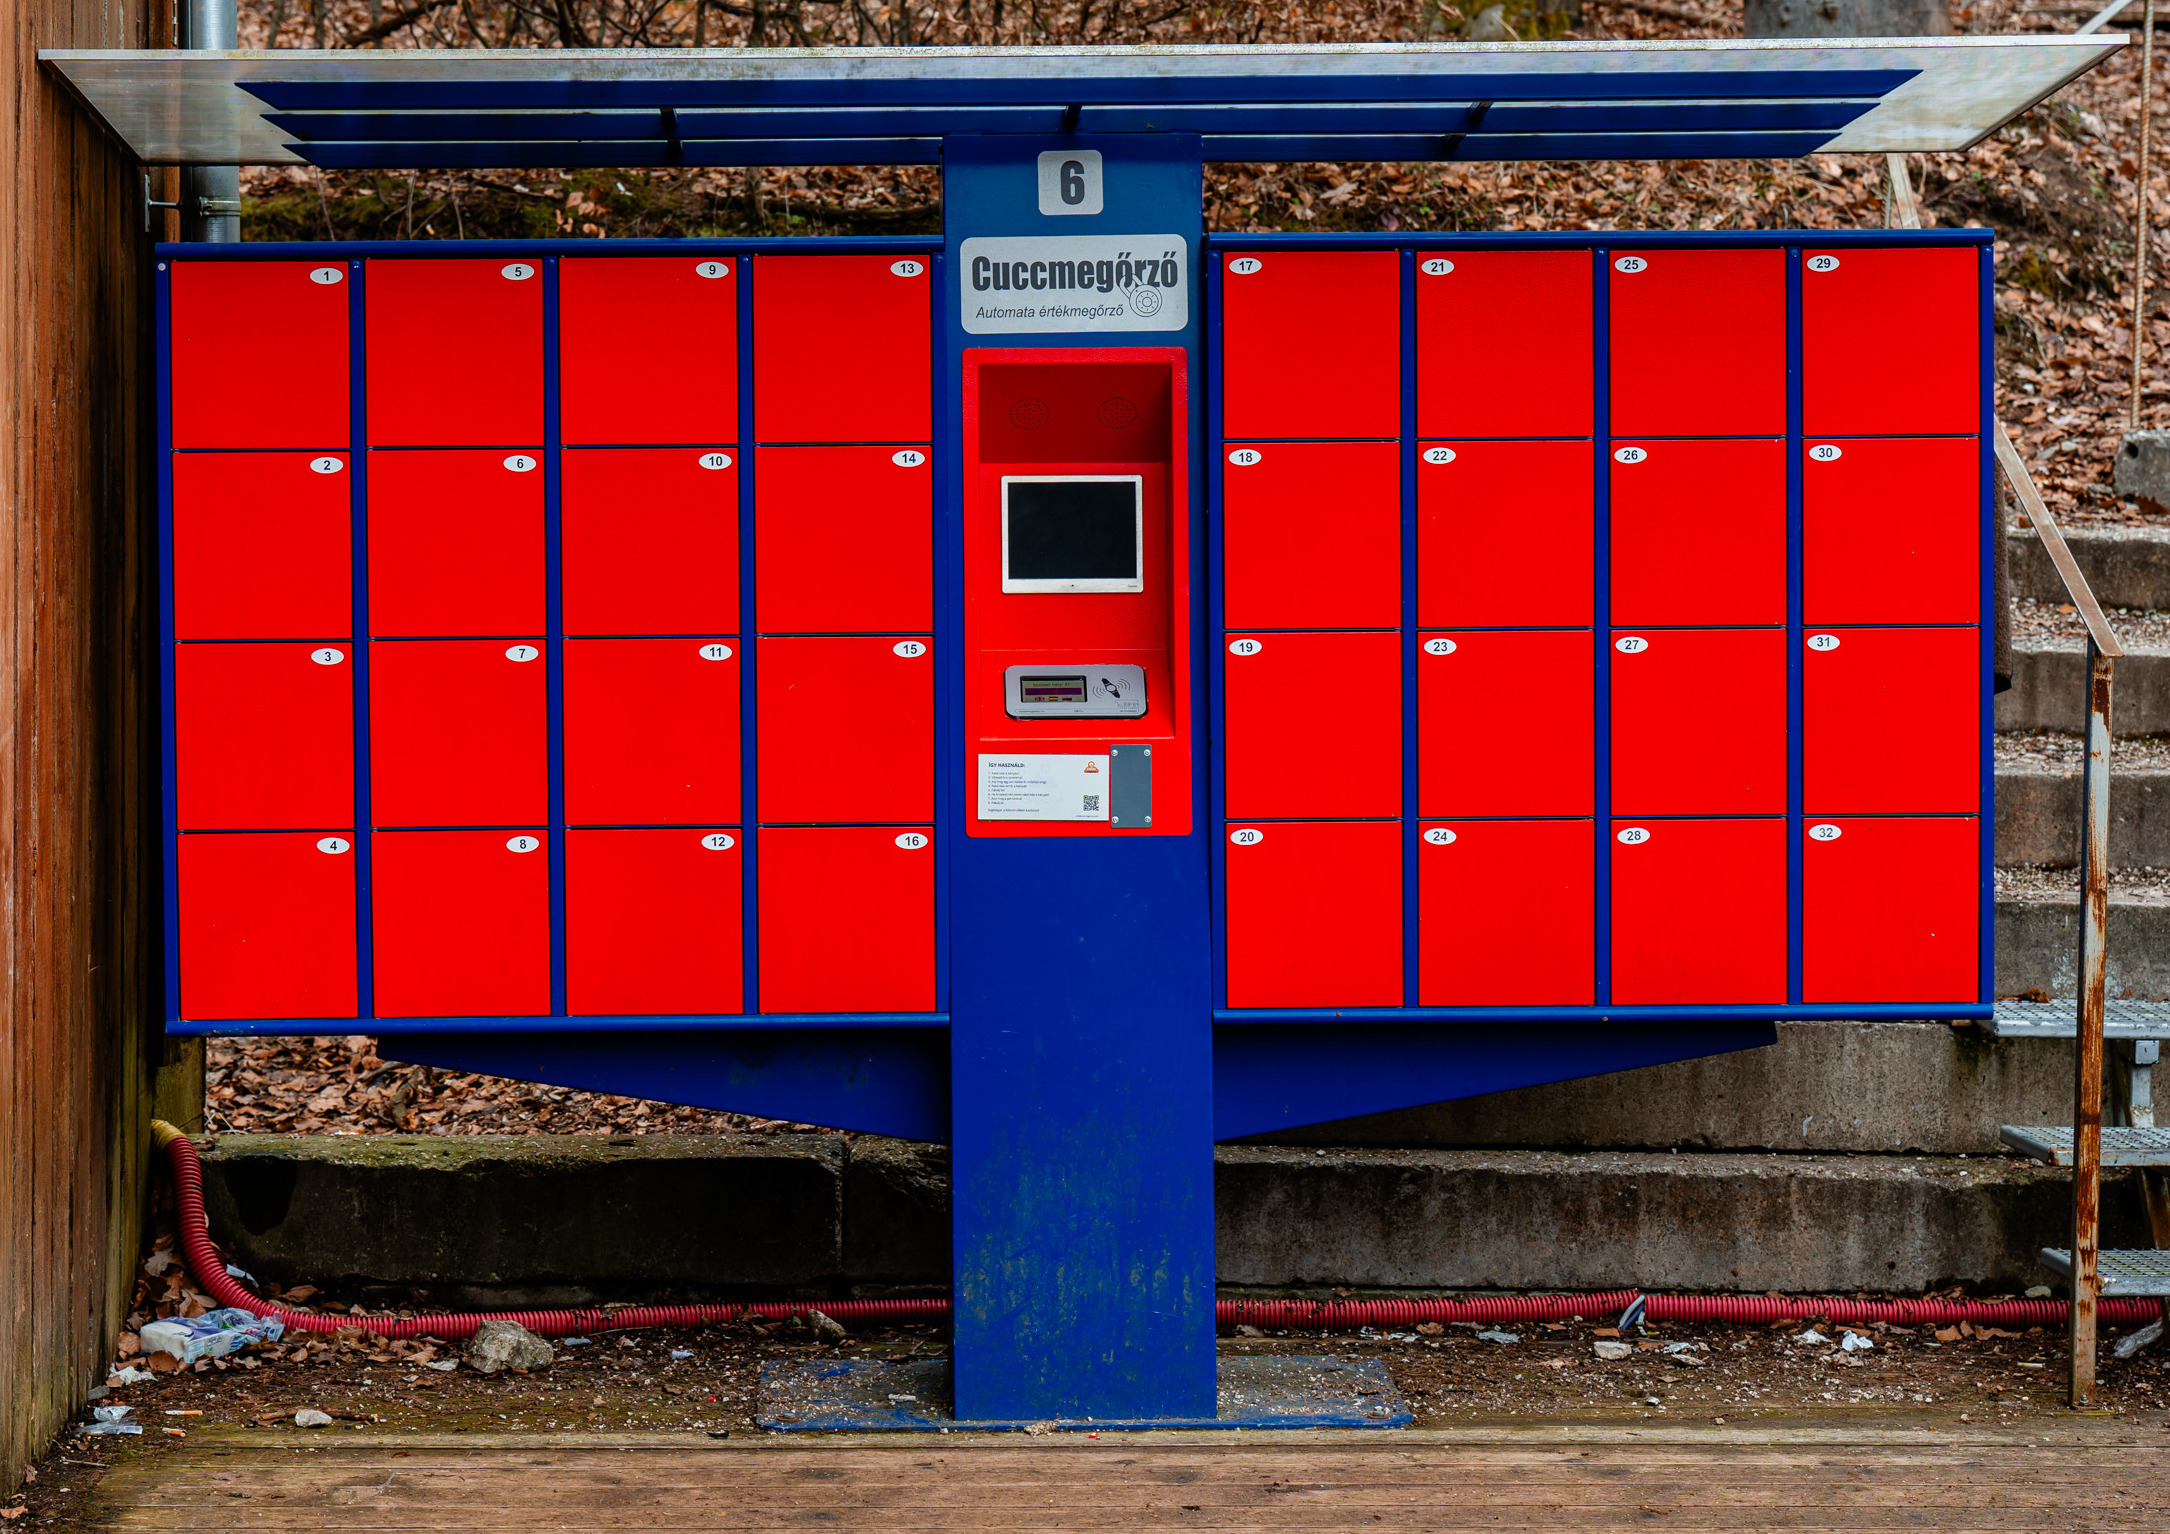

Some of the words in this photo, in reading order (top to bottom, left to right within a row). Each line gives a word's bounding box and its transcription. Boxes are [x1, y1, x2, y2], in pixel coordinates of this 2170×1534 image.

[1060, 160, 1085, 205] 6
[900, 262, 915, 274] 13
[1238, 260, 1254, 272] 17
[1430, 261, 1444, 273] 21
[1624, 259, 1639, 270] 25
[1816, 257, 1831, 269] 29
[514, 266, 522, 277] 5
[708, 264, 717, 275] 9
[972, 251, 1179, 293] Cuccmegőrző
[323, 270, 330, 282] 1
[976, 305, 1035, 319] Automata
[1039, 304, 1124, 319] értékmegőrző
[1238, 452, 1253, 463] 18
[1432, 450, 1447, 461] 22
[1623, 450, 1638, 460] 26
[1818, 447, 1833, 458] 30
[516, 458, 524, 469] 6
[708, 455, 723, 467] 10
[902, 453, 916, 464] 14
[323, 460, 331, 471] 2
[1433, 641, 1448, 652] 23
[1625, 639, 1639, 650] 27
[1816, 636, 1830, 647] 31
[709, 646, 722, 658] 11
[903, 644, 918, 655] 15
[1239, 642, 1253, 653] 19
[324, 651, 332, 662] 3
[518, 648, 526, 659] 7
[1240, 831, 1255, 842] 20
[1433, 831, 1448, 842] 24
[1627, 830, 1641, 841] 28
[1819, 827, 1833, 838] 32
[329, 840, 338, 851] 4
[519, 839, 527, 850] 8
[711, 836, 726, 847] 12
[905, 835, 919, 846] 16
